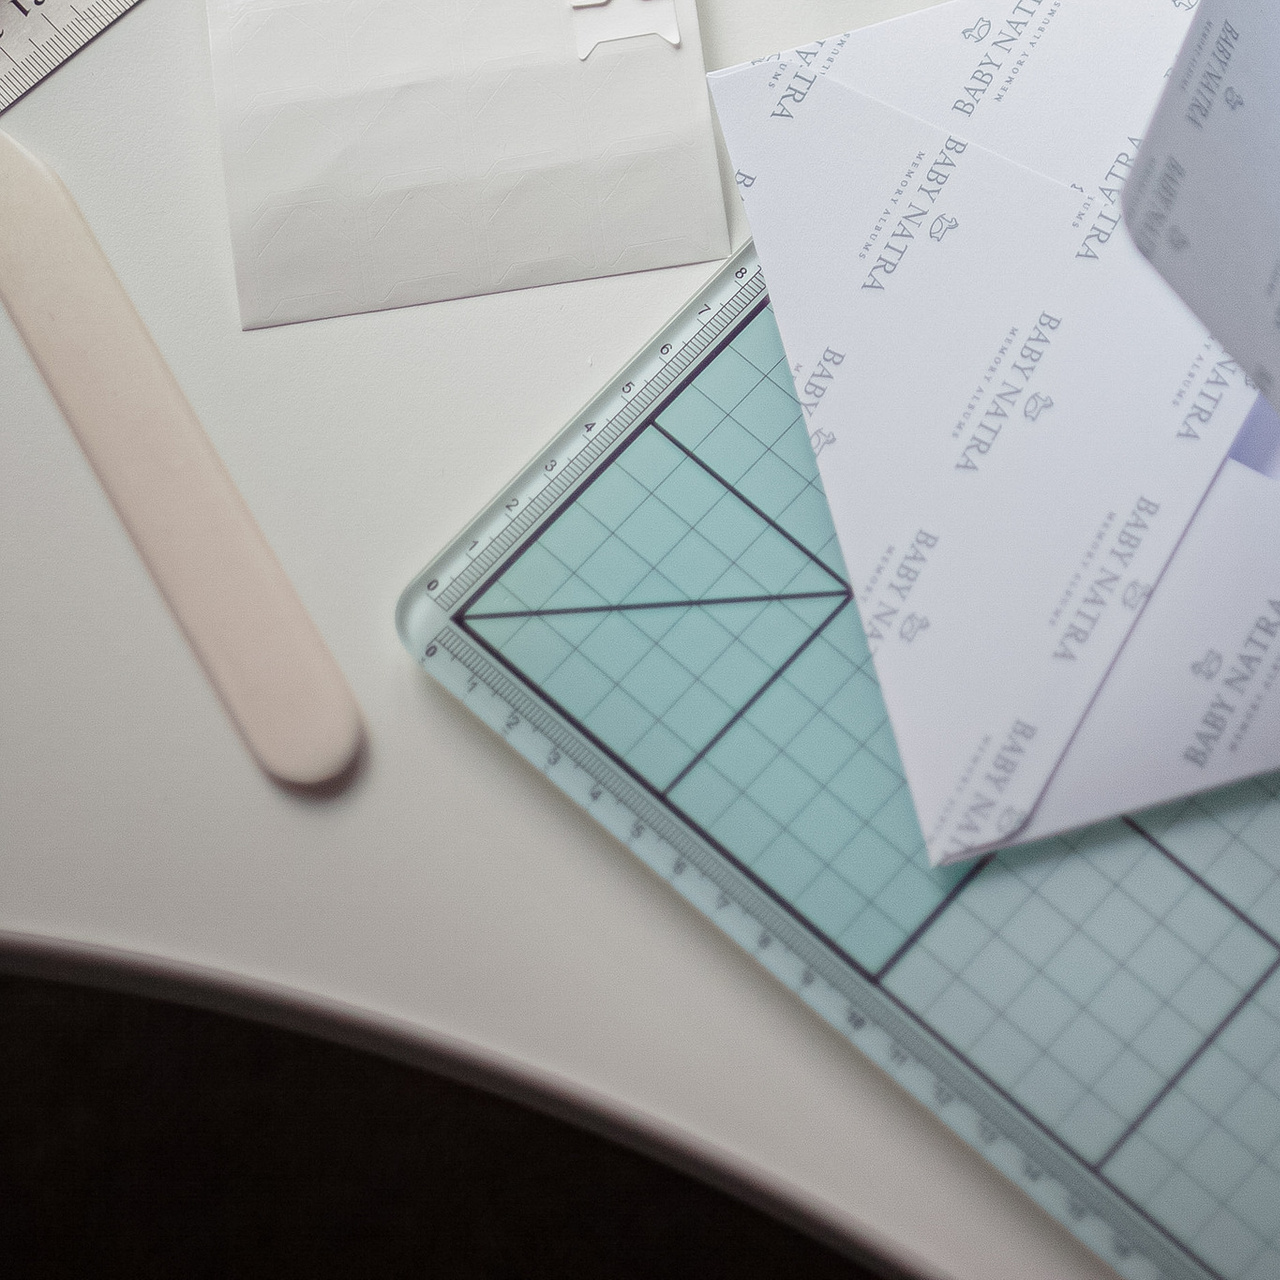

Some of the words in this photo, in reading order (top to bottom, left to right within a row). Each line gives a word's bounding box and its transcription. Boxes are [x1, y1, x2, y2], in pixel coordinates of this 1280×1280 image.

[1211, 18, 1240, 74] BABY
[769, 70, 818, 120] TRA
[951, 53, 1003, 118] BABY
[993, 51, 1031, 102] MEMORY
[889, 149, 926, 207] MEMORY
[916, 135, 968, 204] BABY
[857, 207, 892, 261] ALBUMS
[860, 199, 930, 292] NATRA
[1074, 210, 1123, 261] TRA
[734, 266, 749, 281] 8
[696, 302, 713, 318] 7
[659, 341, 674, 357] 6
[982, 326, 1020, 383] MEMORY
[1011, 310, 1063, 383] BABY
[621, 381, 637, 395] 5
[800, 345, 847, 418] BABY
[1175, 351, 1237, 441] NATRA
[583, 421, 598, 435] 4
[953, 381, 1024, 473] NATRA
[544, 459, 558, 474] 3
[505, 498, 520, 513] 2
[1109, 495, 1161, 568] BABY
[426, 578, 441, 593] 0
[886, 528, 940, 606] BABY
[1051, 566, 1123, 663] NATRA
[424, 644, 438, 659] 0
[1182, 693, 1237, 769] BABY
